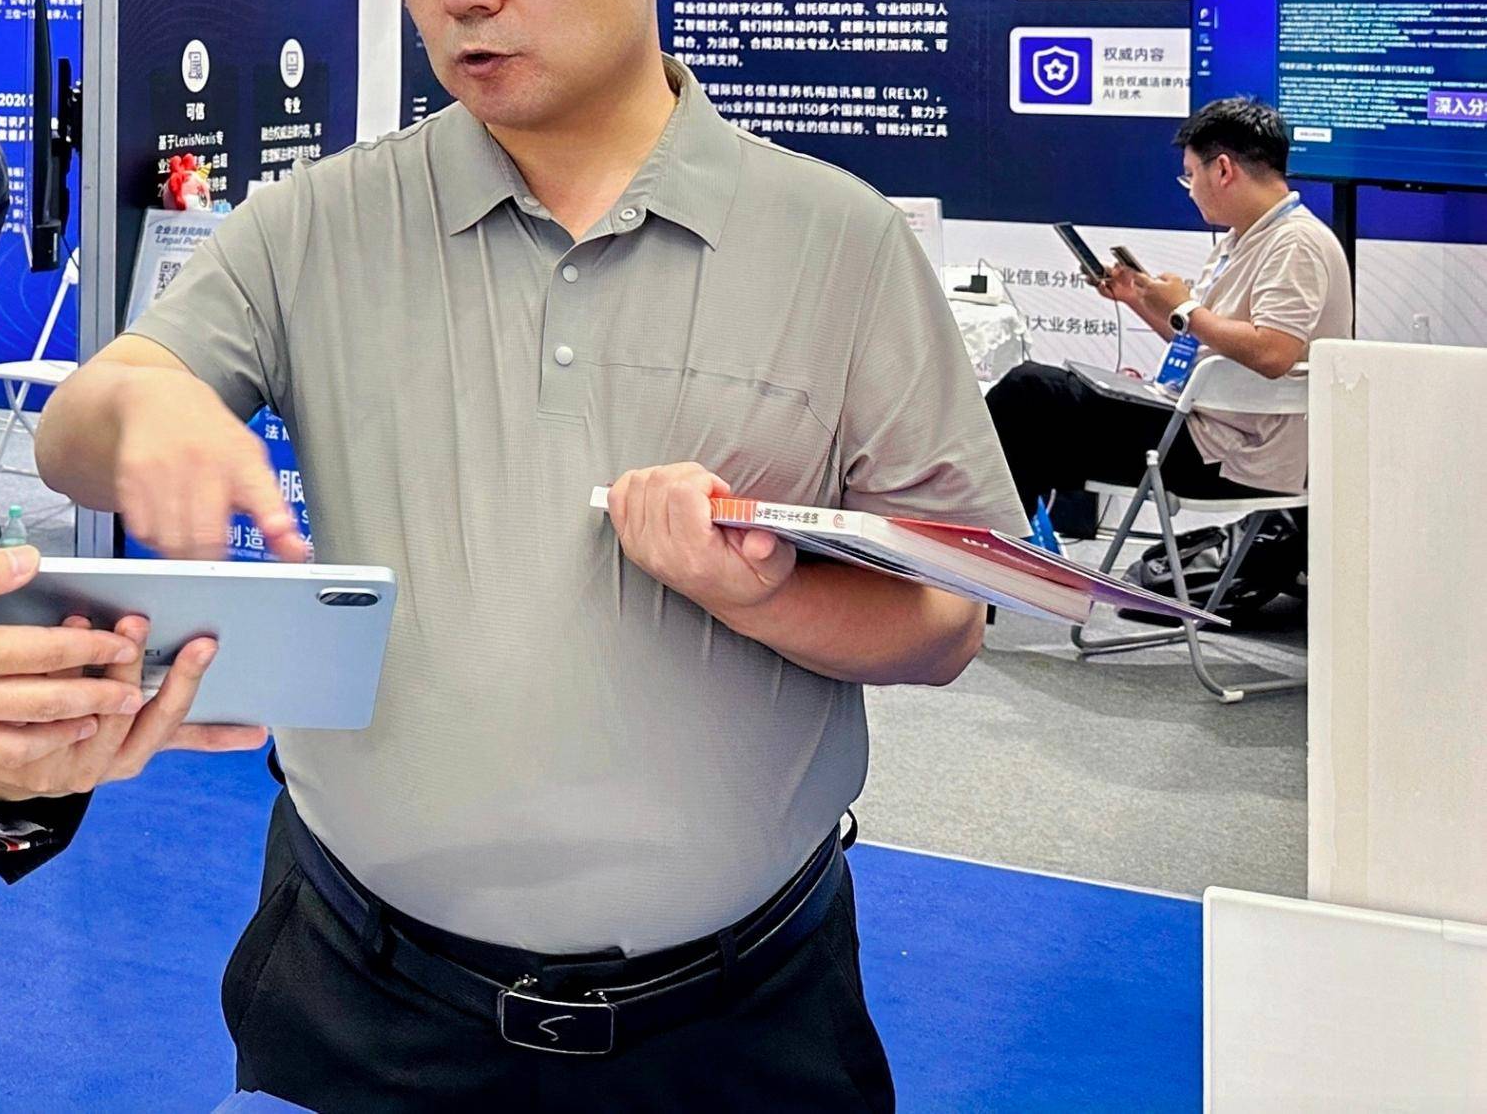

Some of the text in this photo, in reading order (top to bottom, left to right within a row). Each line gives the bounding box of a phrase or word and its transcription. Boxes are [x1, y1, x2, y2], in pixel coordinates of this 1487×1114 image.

[1104, 47, 1165, 62] 权威内容
[1119, 89, 1142, 100] 技术
[186, 102, 206, 122] 可信
[1025, 314, 1117, 337] 大业务板块
